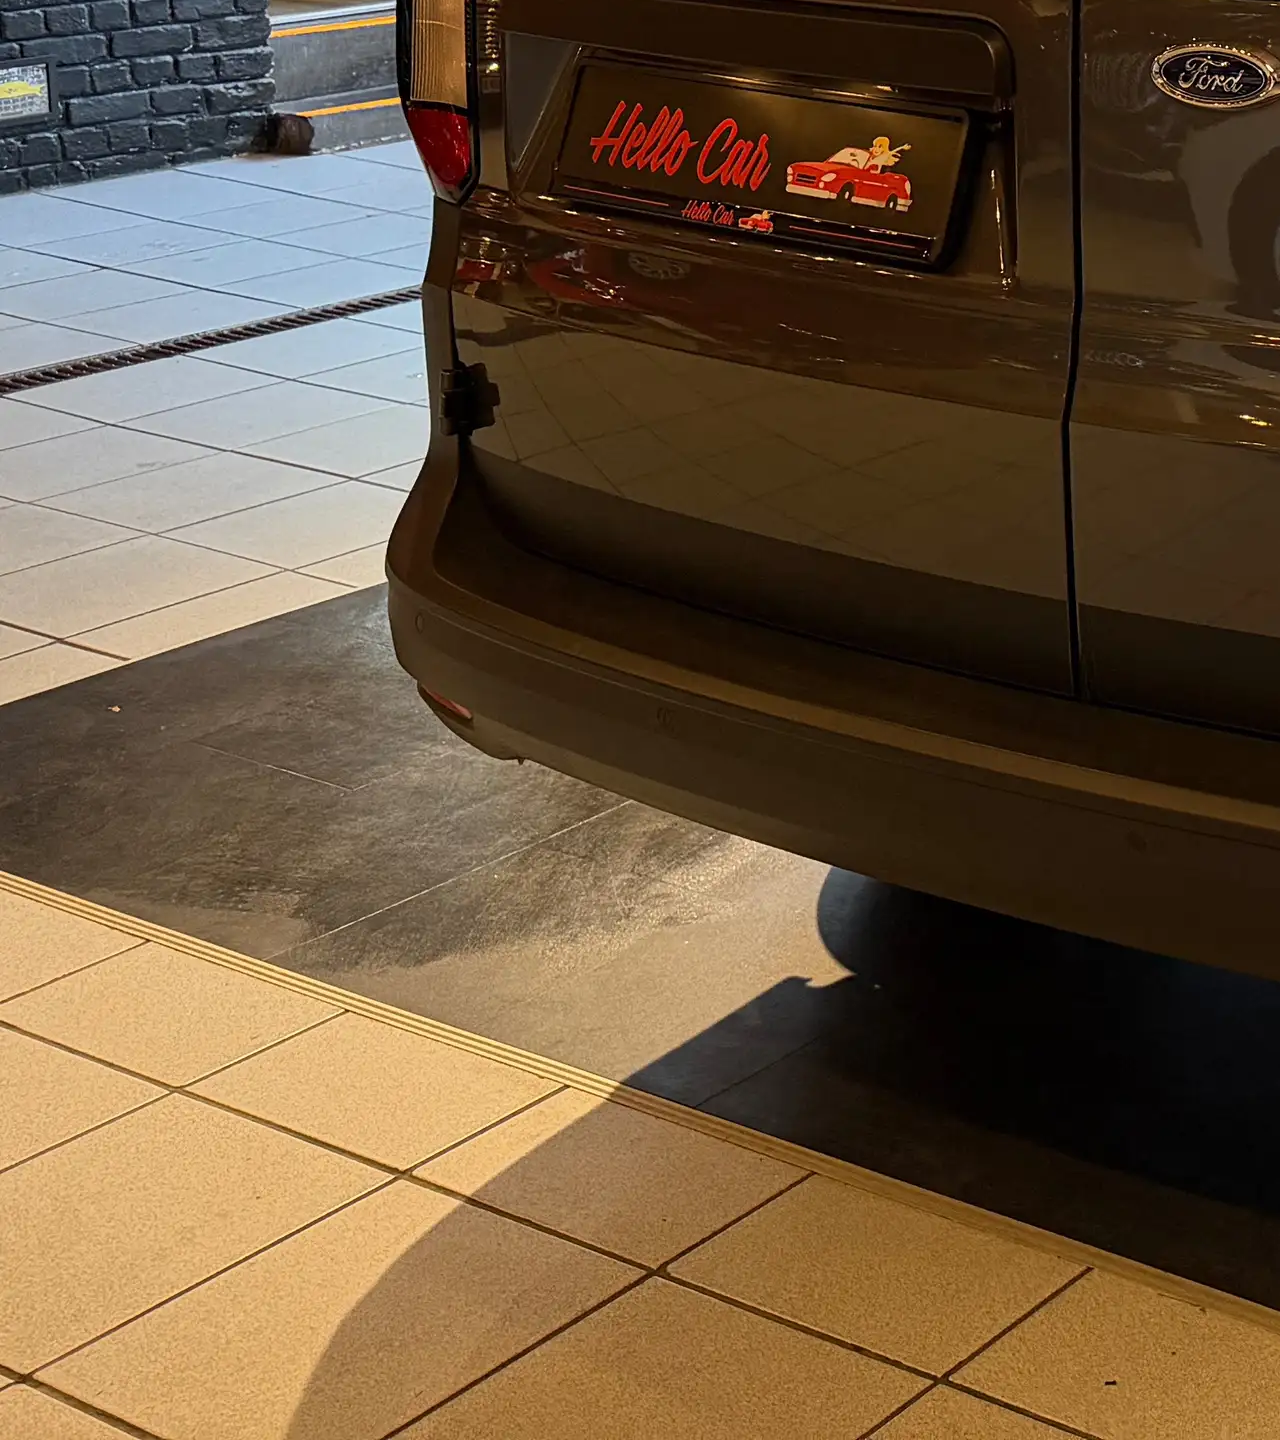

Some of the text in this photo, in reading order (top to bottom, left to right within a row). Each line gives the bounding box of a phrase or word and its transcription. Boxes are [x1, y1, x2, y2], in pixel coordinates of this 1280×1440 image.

[1177, 56, 1246, 94] Ford
[590, 99, 772, 193] Hello Car
[681, 199, 735, 227] Hello Car
